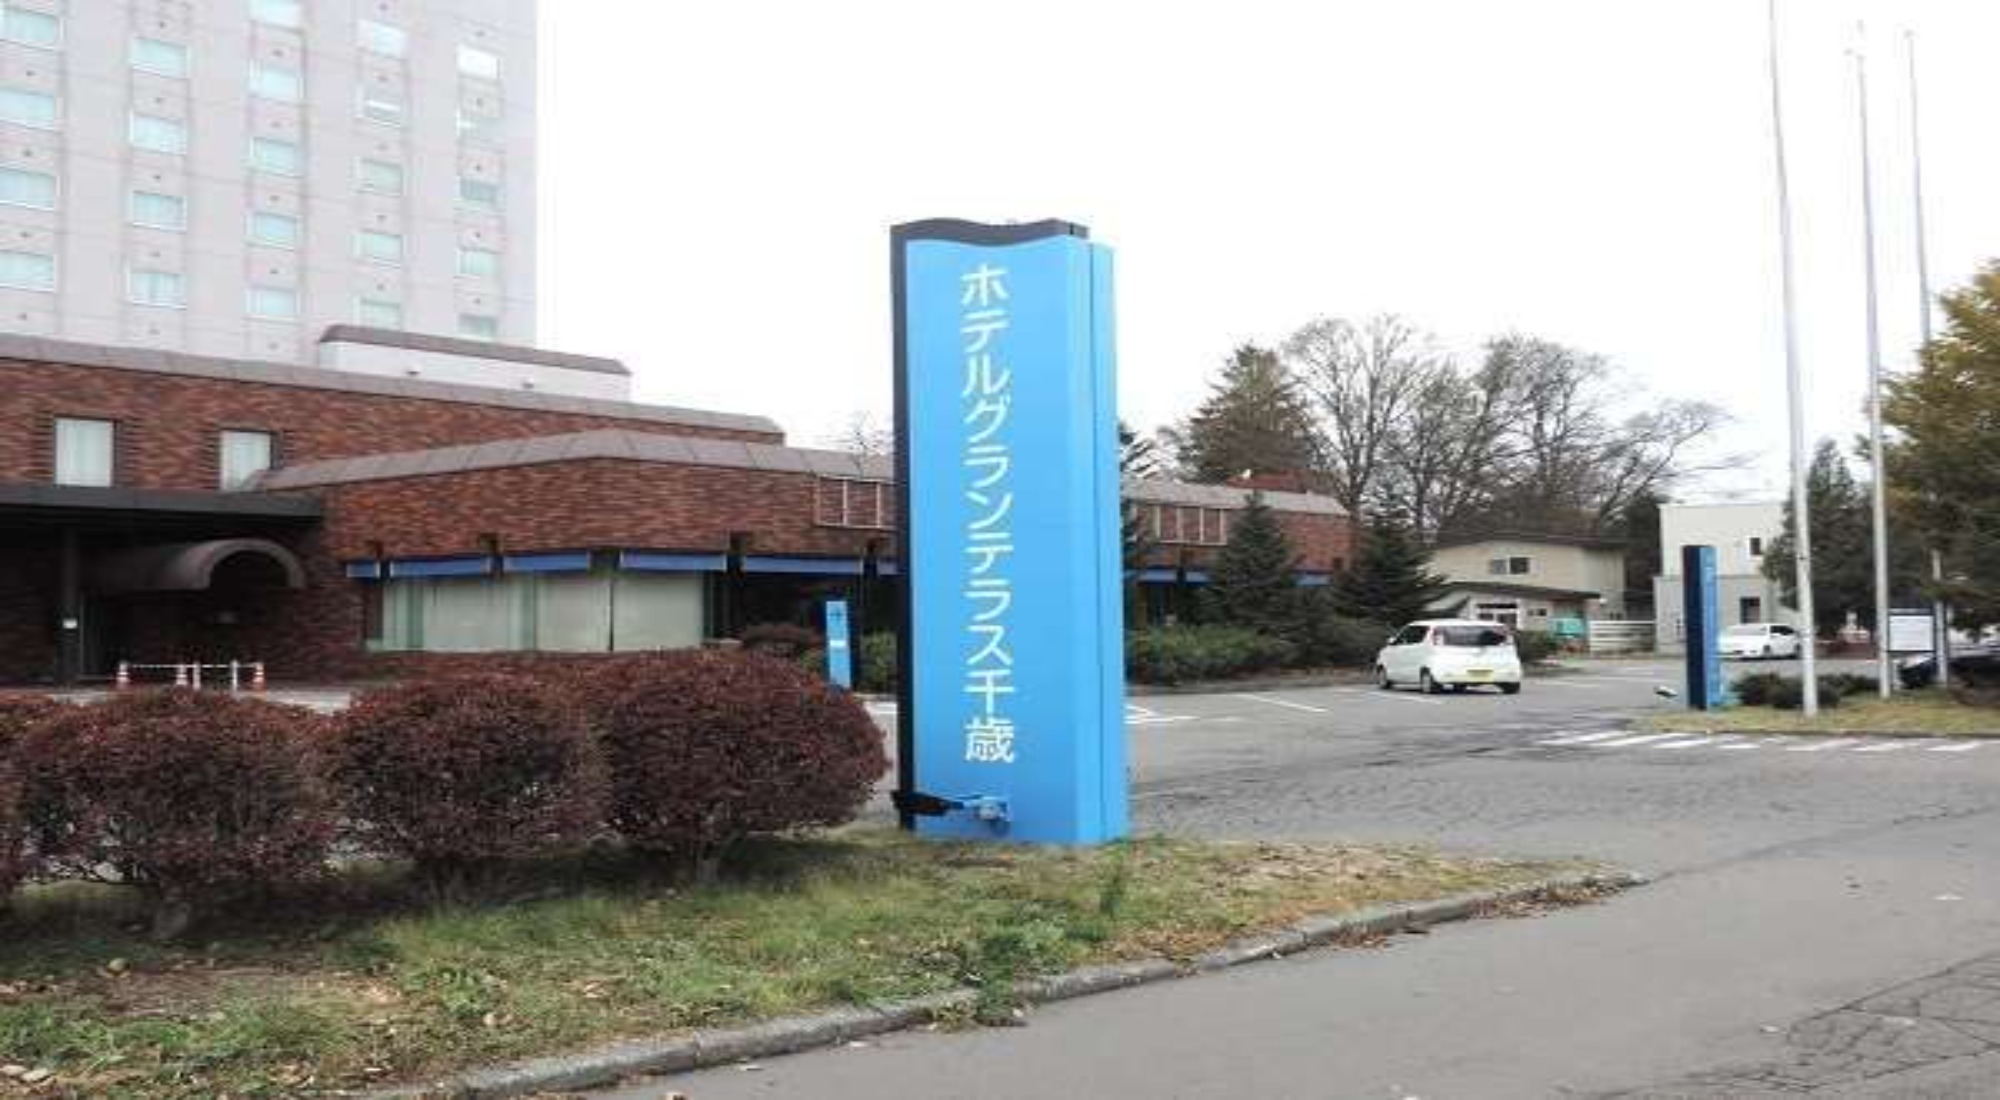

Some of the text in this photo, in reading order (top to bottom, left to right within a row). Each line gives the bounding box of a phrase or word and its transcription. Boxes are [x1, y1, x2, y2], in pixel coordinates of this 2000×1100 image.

[960, 263, 1016, 763] ホテルグランテラス千歳
